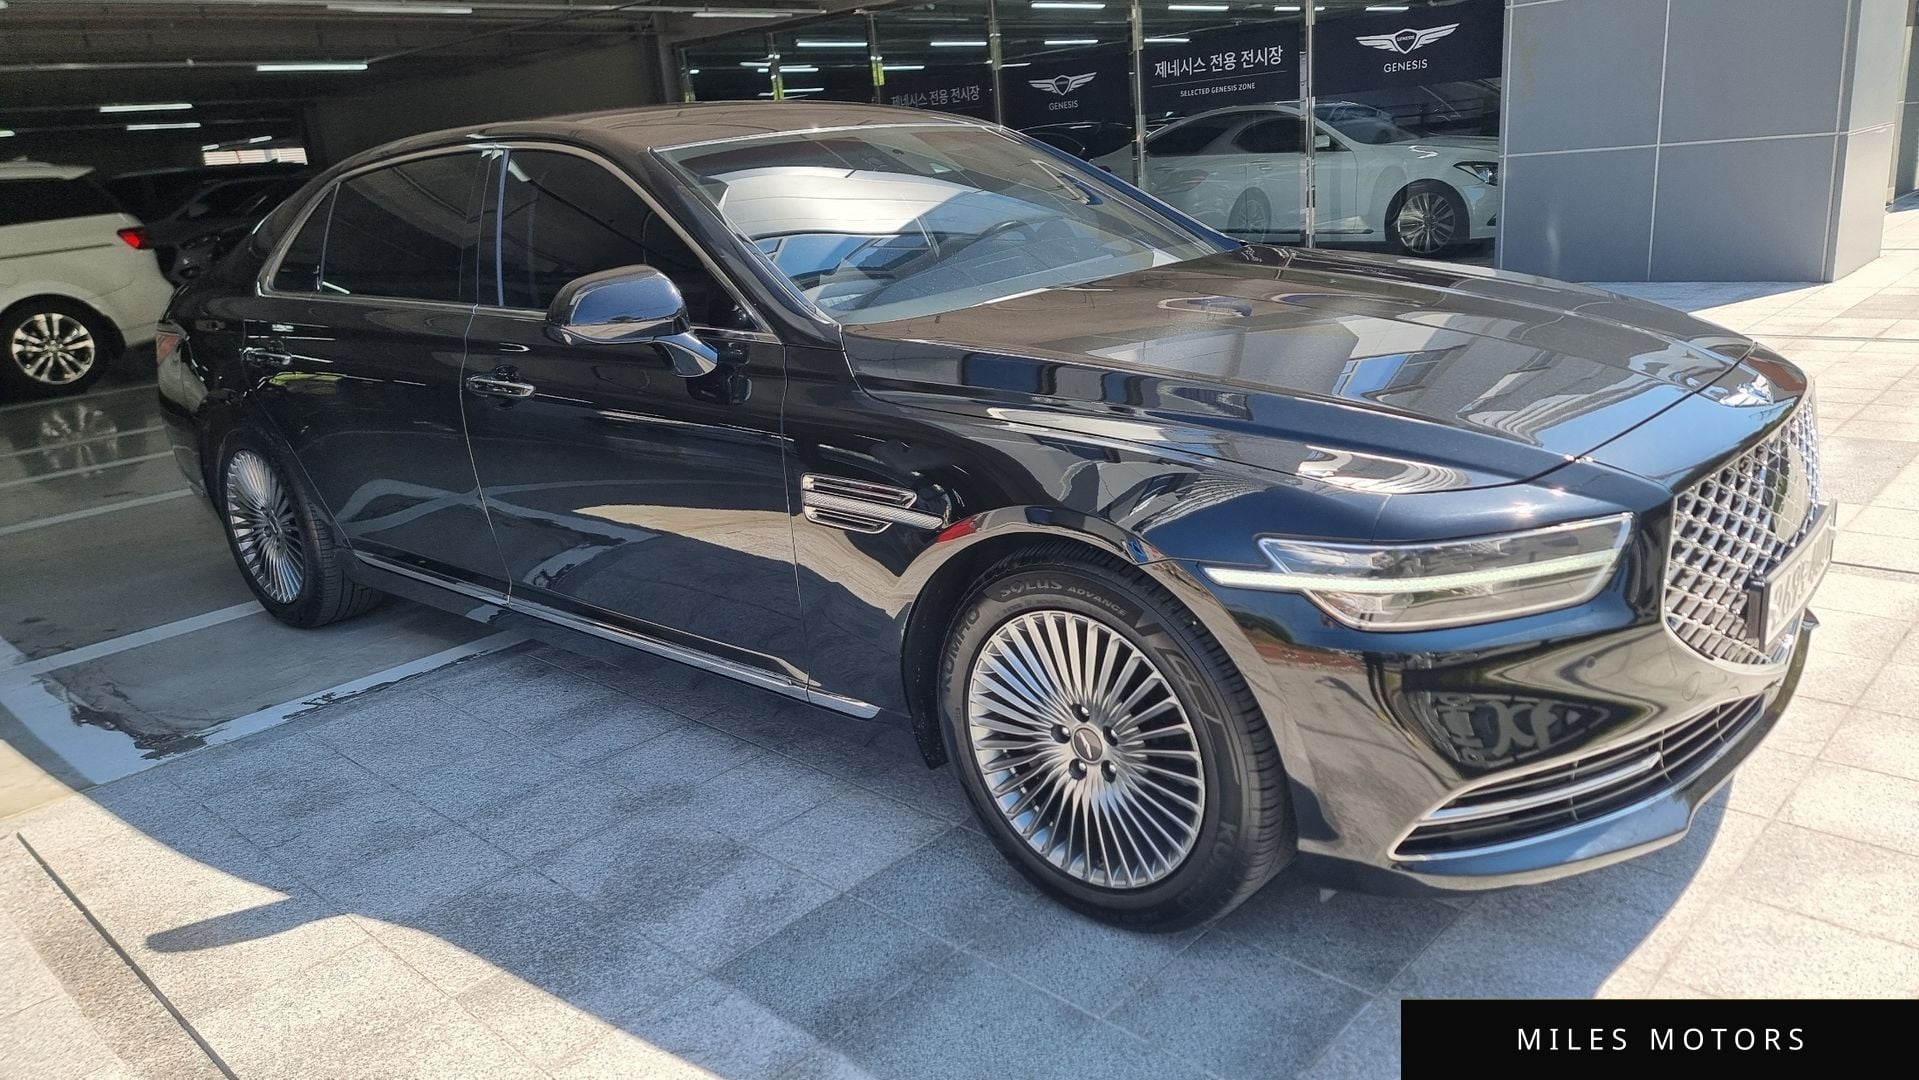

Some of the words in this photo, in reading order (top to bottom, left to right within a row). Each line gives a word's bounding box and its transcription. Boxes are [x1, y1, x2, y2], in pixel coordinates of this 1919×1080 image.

[1154, 56, 1207, 79] 제네시스
[1209, 52, 1237, 73] 전용
[1240, 44, 1284, 69] 전시장
[1383, 58, 1428, 73] GENESIS
[928, 89, 949, 105] 전용
[950, 85, 980, 102] 전시장
[1180, 87, 1210, 98] SELECTED
[1211, 84, 1238, 94] GENESIS
[1238, 82, 1256, 91] ZONE
[1048, 99, 1079, 111] GENESIS
[1000, 579, 1063, 597] SOLUS
[1067, 586, 1128, 616] ADVANCE
